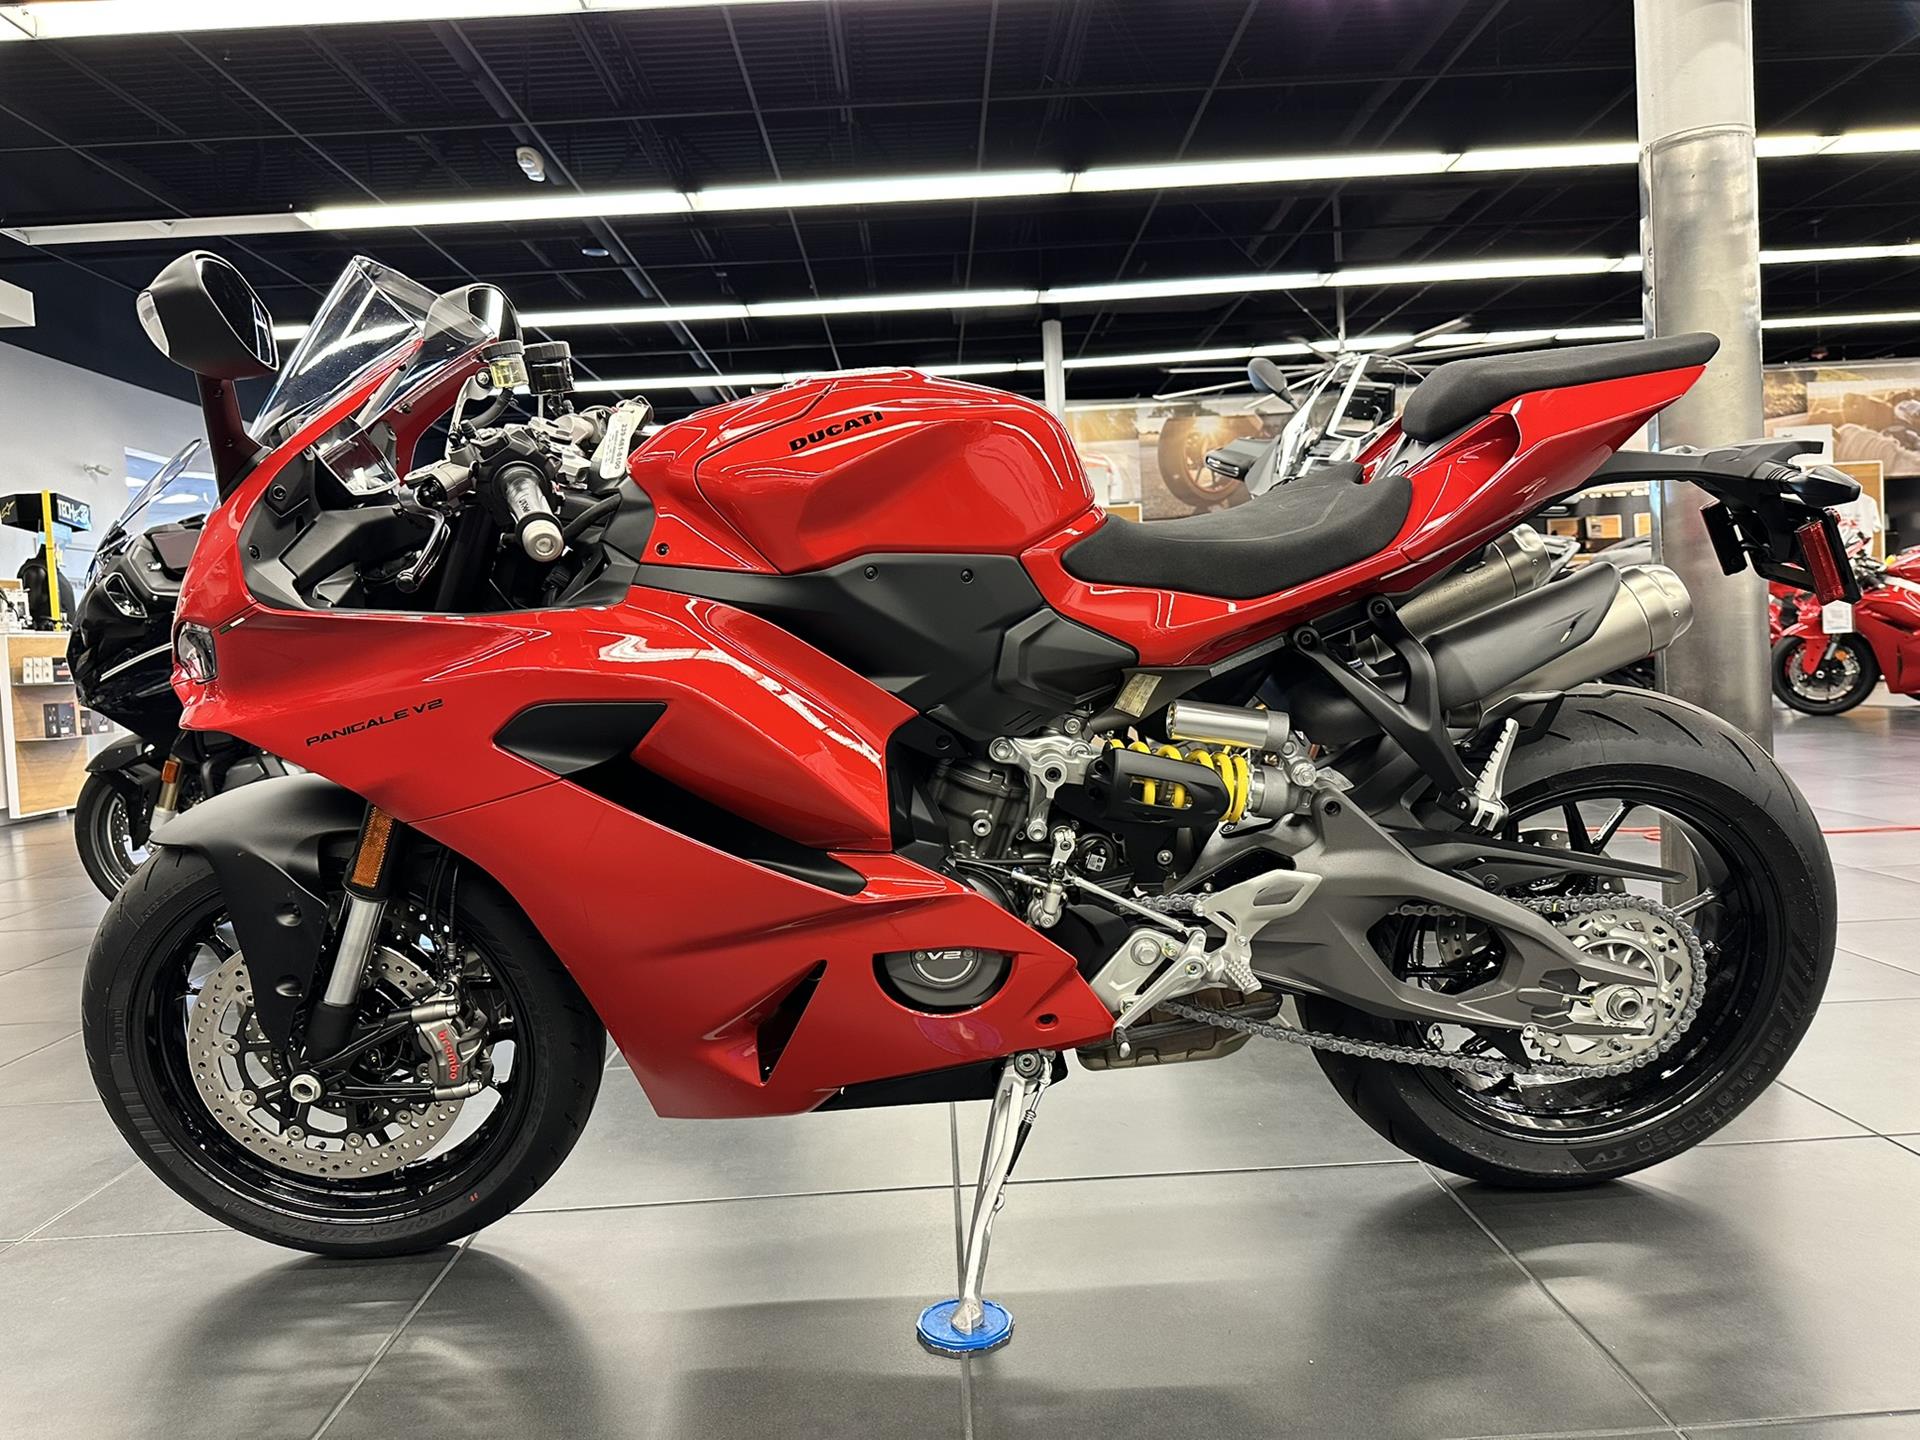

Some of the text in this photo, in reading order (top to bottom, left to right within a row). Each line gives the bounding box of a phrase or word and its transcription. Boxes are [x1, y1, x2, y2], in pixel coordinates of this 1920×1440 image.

[789, 411, 884, 452] DUCATI
[306, 698, 443, 747] PANIGALE V2
[927, 950, 962, 961] V2
[438, 1030, 458, 1080] brembo
